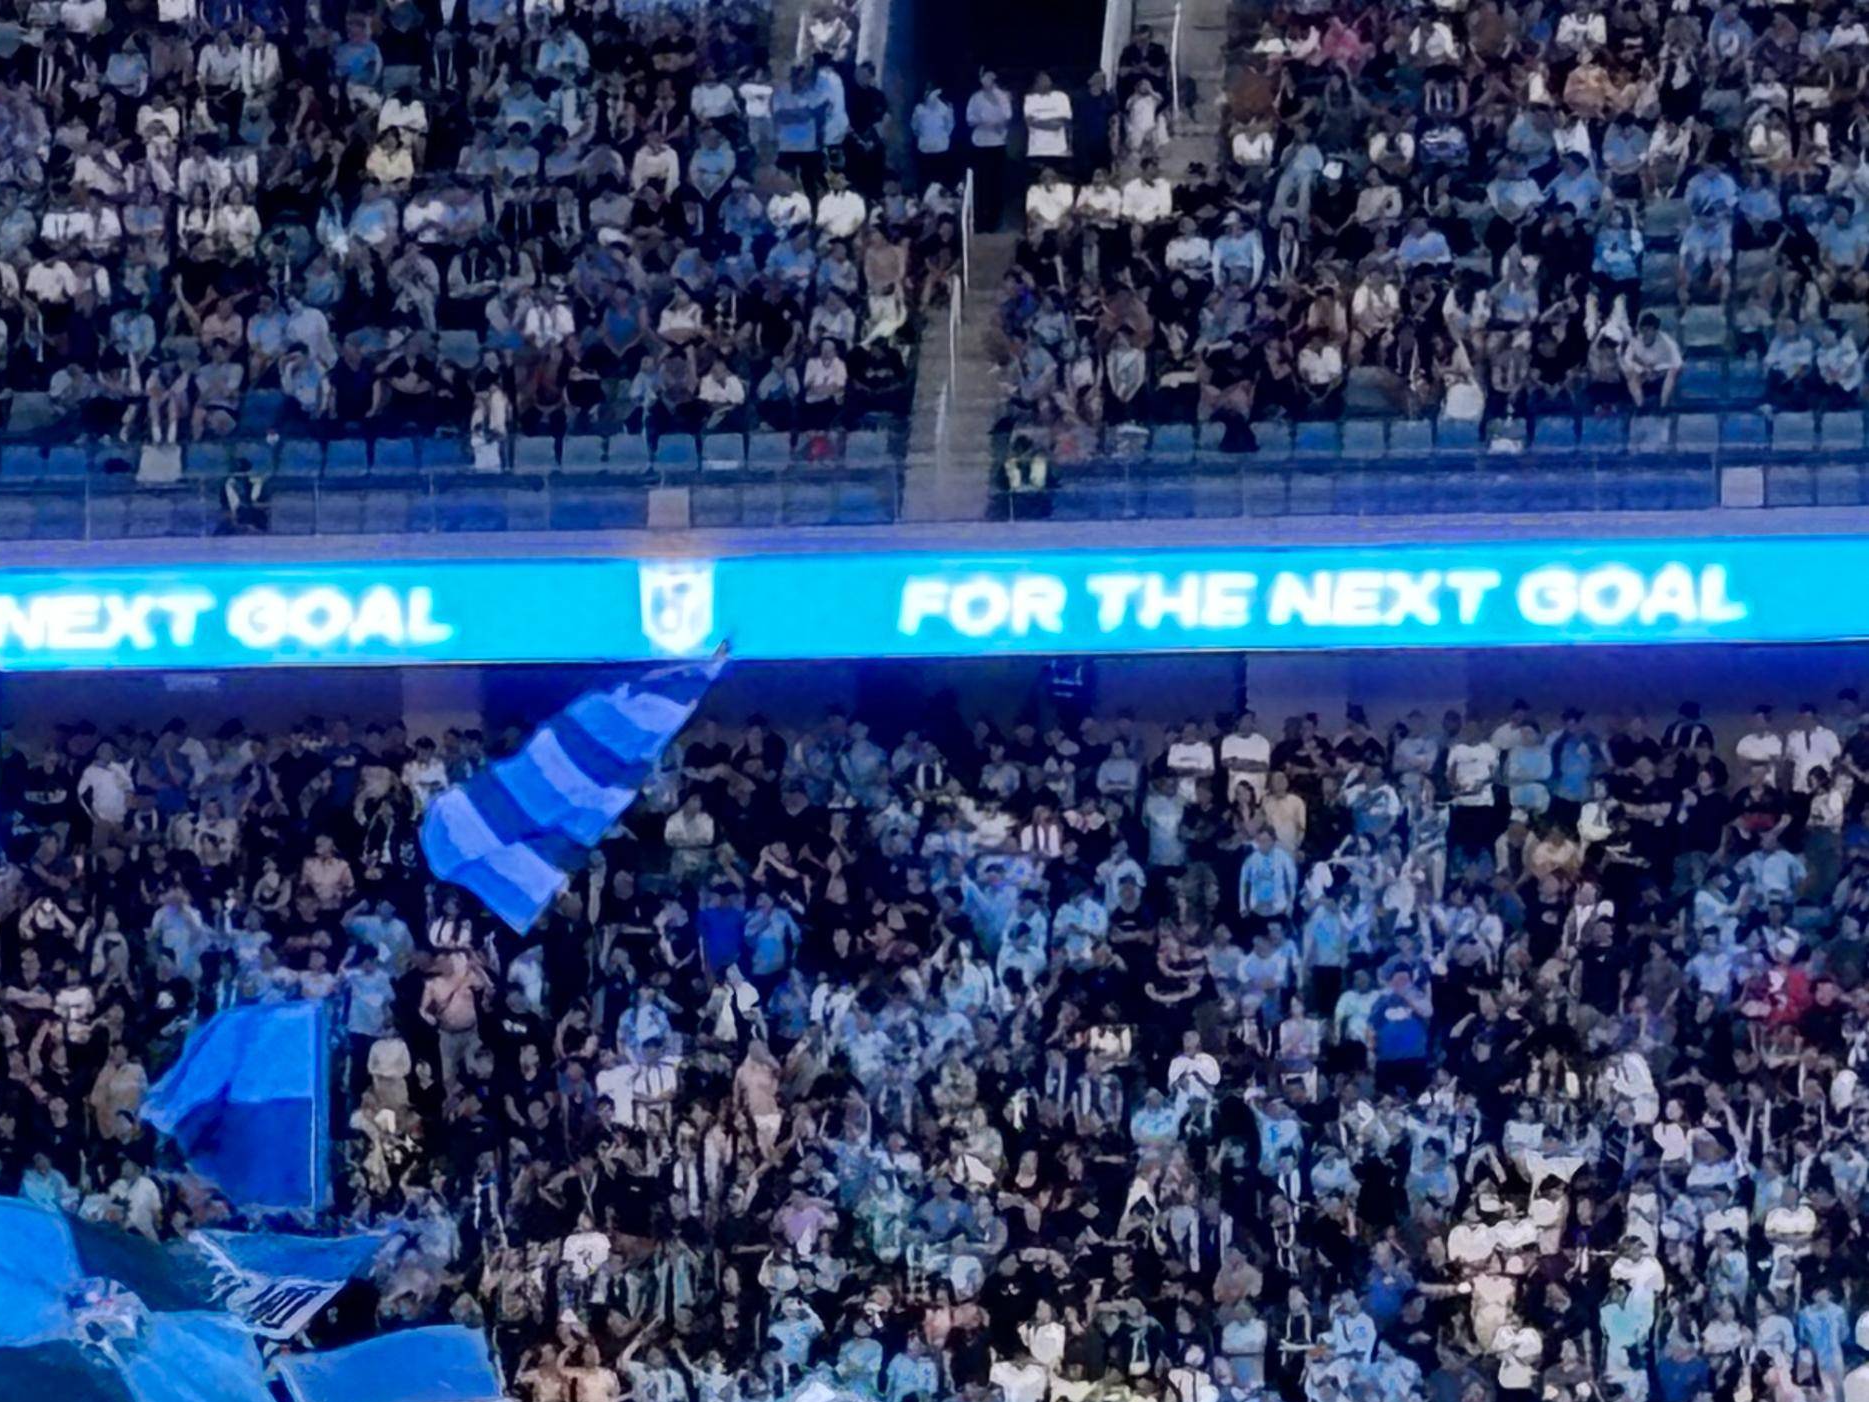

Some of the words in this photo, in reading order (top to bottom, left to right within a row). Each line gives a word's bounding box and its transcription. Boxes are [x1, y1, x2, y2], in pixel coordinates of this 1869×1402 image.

[226, 587, 452, 648] GOAL
[900, 574, 1066, 637] FOR
[1087, 572, 1257, 630] THE
[1268, 569, 1500, 627] NEXT
[1517, 564, 1748, 625] GOAL
